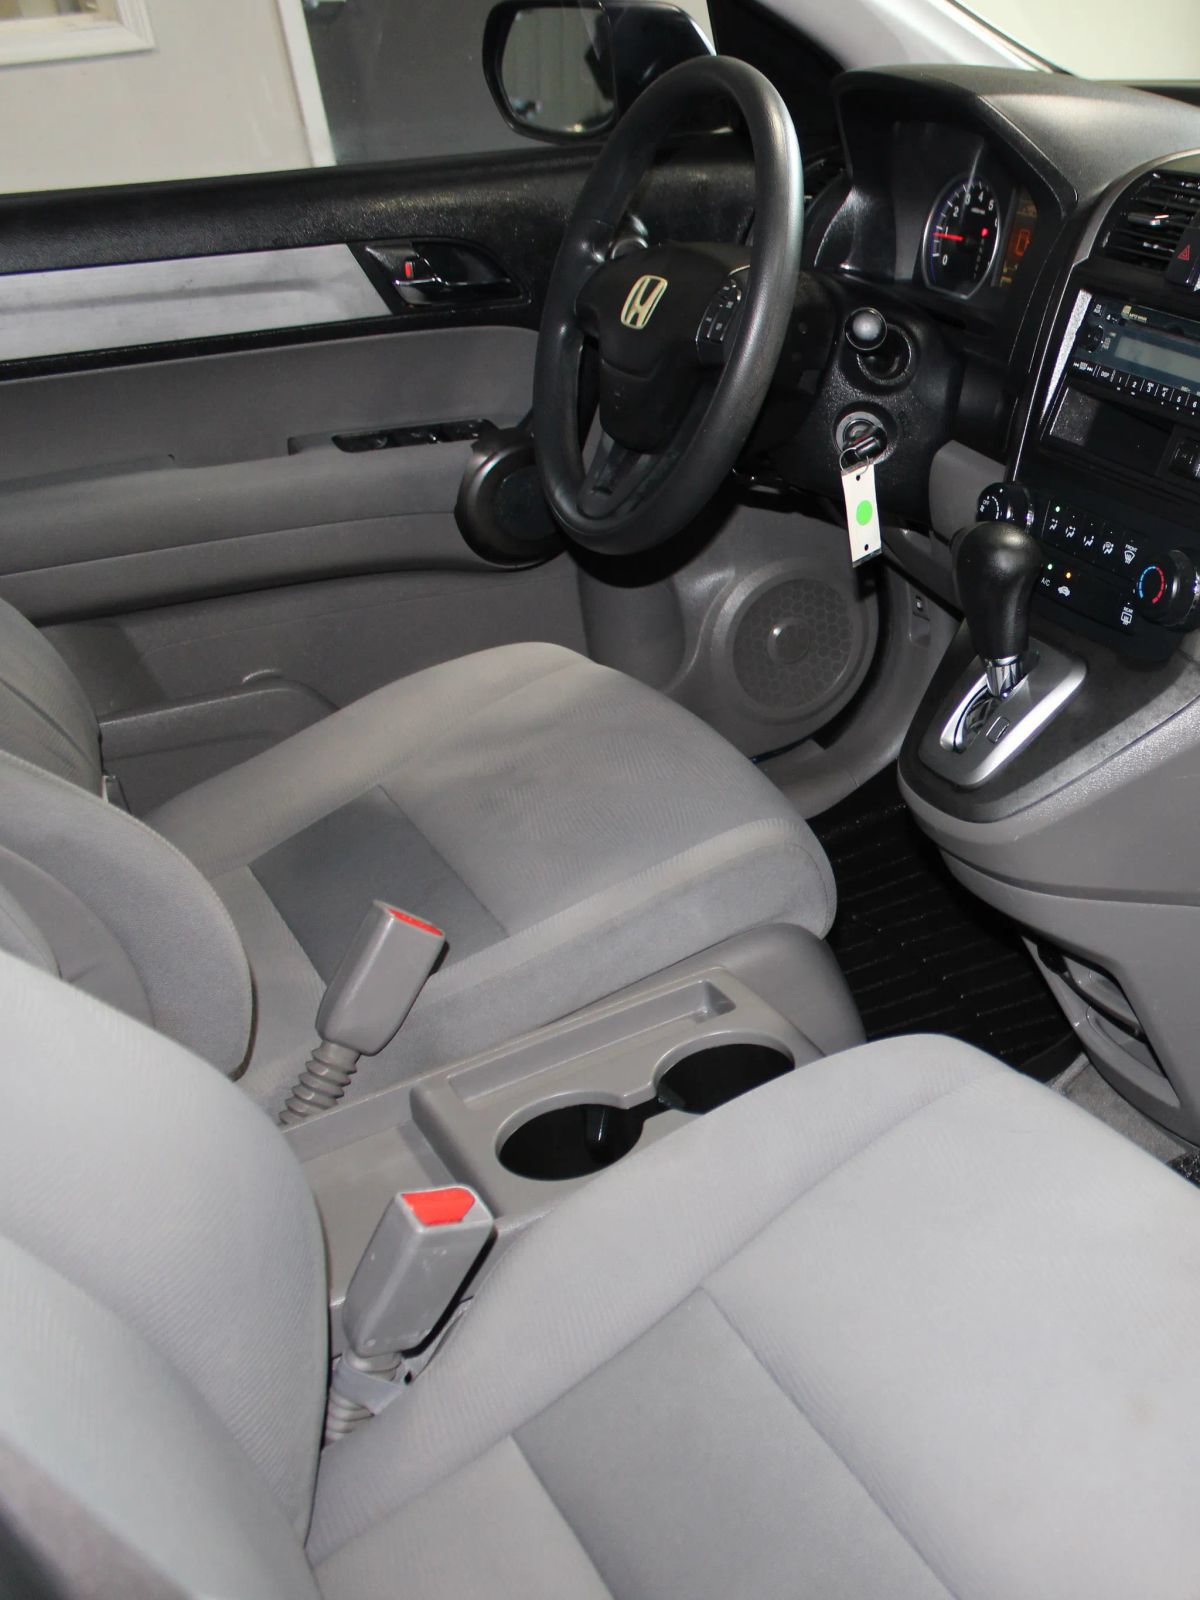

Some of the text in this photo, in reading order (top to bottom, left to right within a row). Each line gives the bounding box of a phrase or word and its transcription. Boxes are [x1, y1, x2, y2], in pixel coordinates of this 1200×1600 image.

[953, 206, 959, 217] 2
[942, 254, 948, 266] 0
[1125, 544, 1138, 553] FRONT
[1041, 577, 1051, 586] A/C
[1123, 606, 1134, 614] REAR
